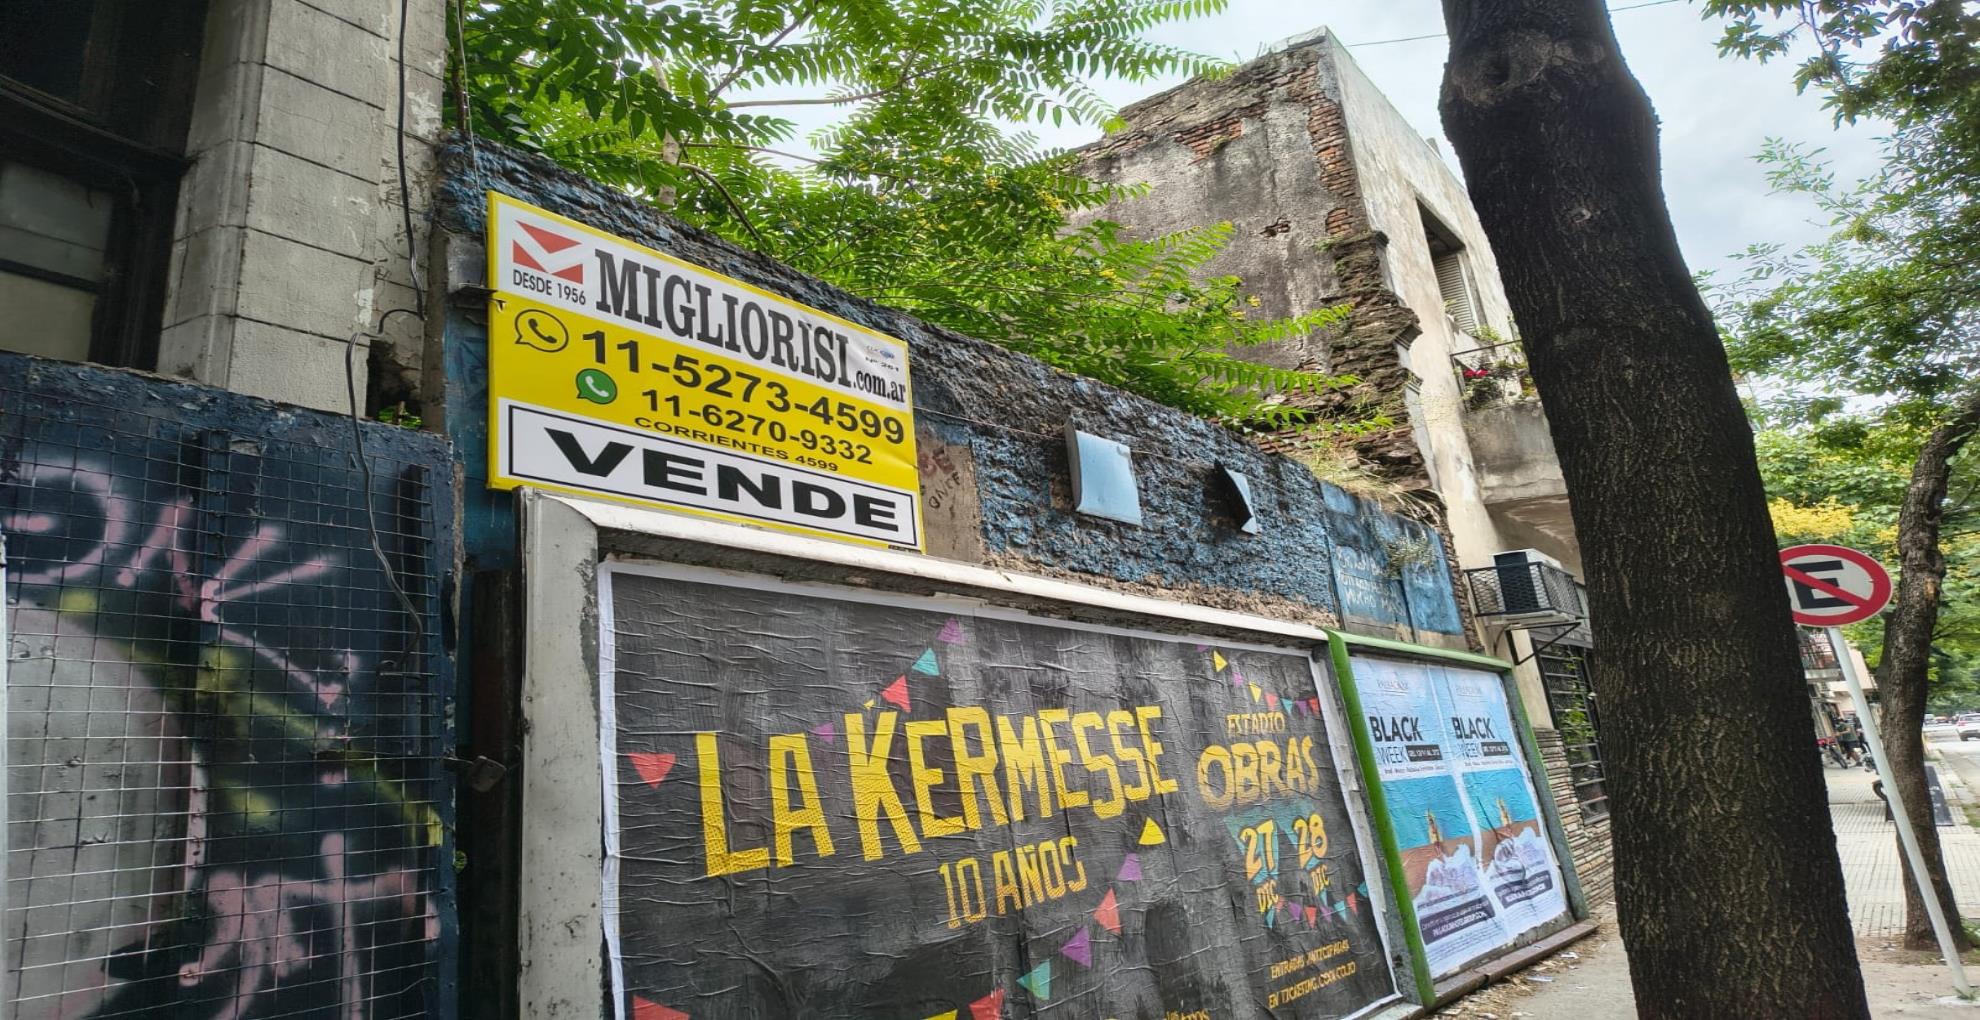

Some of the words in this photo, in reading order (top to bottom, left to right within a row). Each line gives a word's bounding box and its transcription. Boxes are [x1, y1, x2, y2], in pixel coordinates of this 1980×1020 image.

[513, 269, 552, 296] DESDE
[557, 283, 586, 305] 1956
[583, 330, 904, 444] 11-5273-4599
[634, 417, 789, 460] CORRIENTES
[795, 454, 839, 472] 4599
[642, 389, 873, 464] 11-6270-9332
[543, 427, 900, 532] VENDE
[1786, 560, 1858, 609] E
[1226, 711, 1286, 736] ESTADIO
[1369, 716, 1423, 742] BLACK
[1451, 717, 1495, 739] BLACK
[1197, 735, 1320, 812] OBRAS
[1376, 746, 1409, 765] WEEK
[695, 732, 836, 877] LA
[845, 706, 1179, 862] KERMESSE
[1239, 819, 1277, 881] 27
[1293, 813, 1328, 869] 28
[939, 857, 986, 929] 10
[993, 835, 1087, 915] AÑOS
[1256, 879, 1279, 913] DIC
[1310, 865, 1331, 896] DIC
